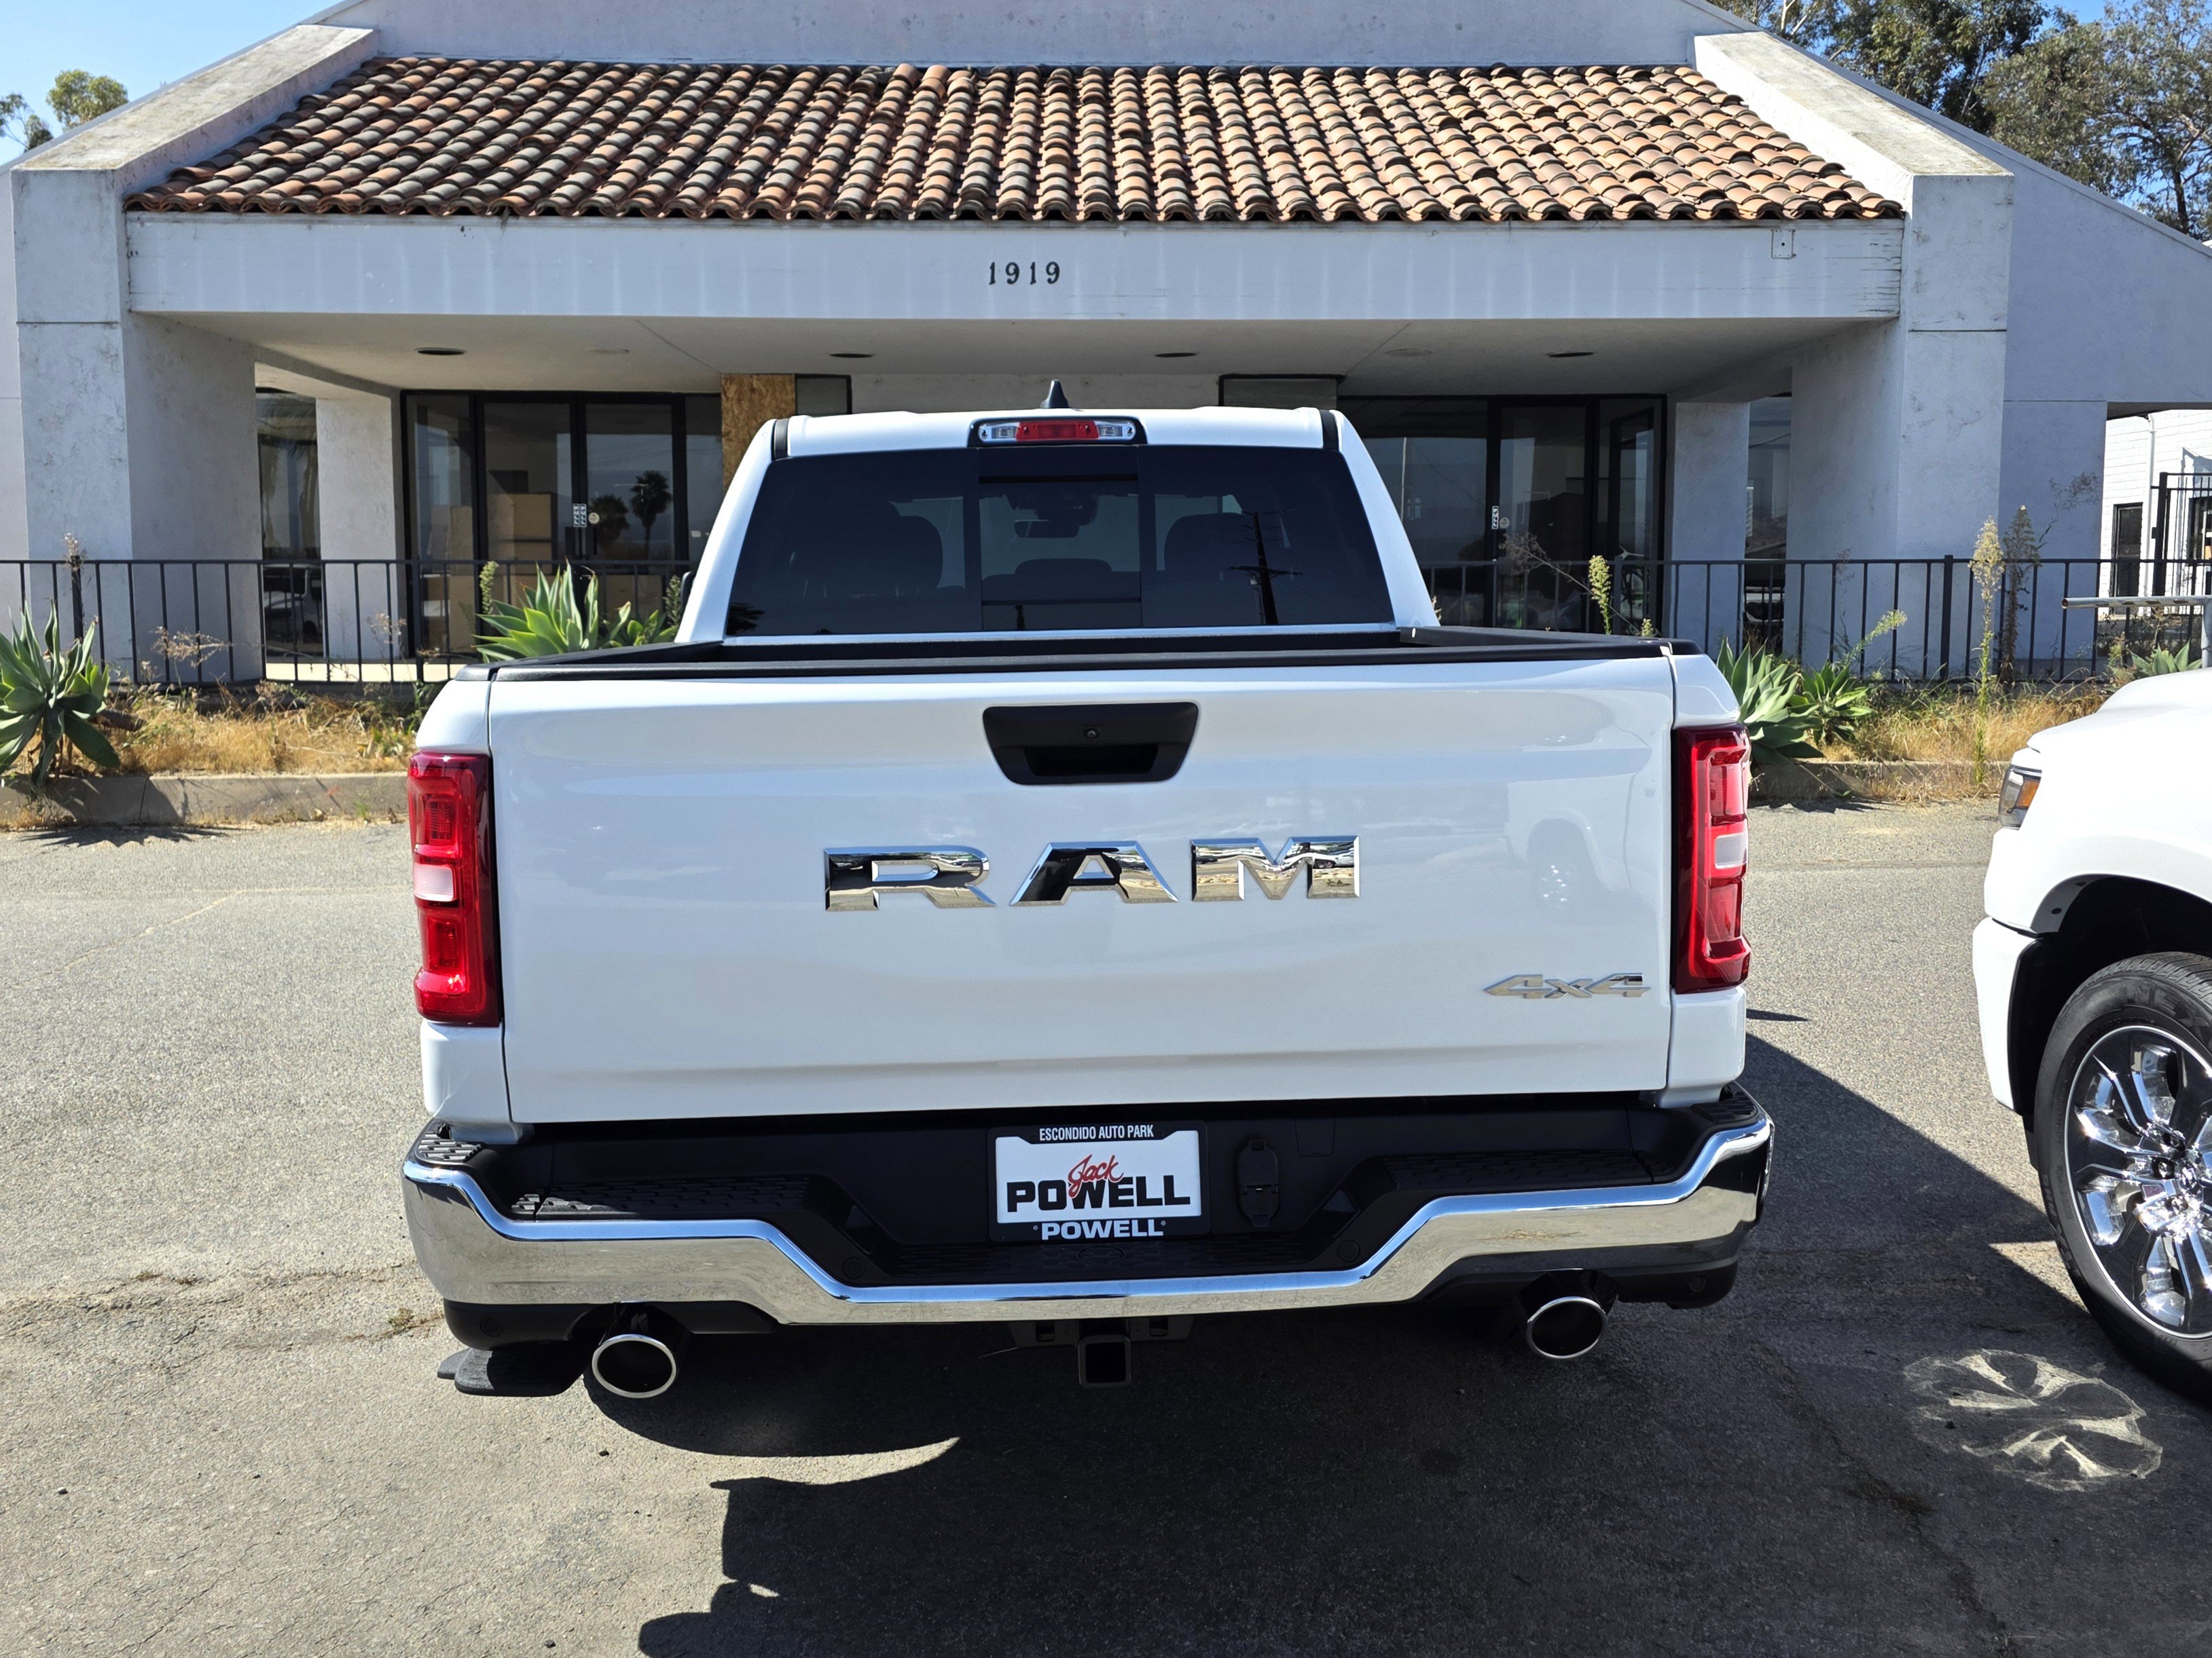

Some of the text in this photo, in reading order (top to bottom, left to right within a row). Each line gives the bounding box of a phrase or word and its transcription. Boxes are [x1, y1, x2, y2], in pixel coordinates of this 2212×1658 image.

[989, 261, 1060, 285] 1919
[823, 834, 1360, 912] RAM
[2125, 980, 2212, 1050] NEX
[1039, 1124, 1154, 1141] ESCONDIDO AUTO PARK
[1007, 1175, 1191, 1213] POWELL
[1068, 1154, 1124, 1199] Jack
[1041, 1219, 1164, 1240] POWELL
